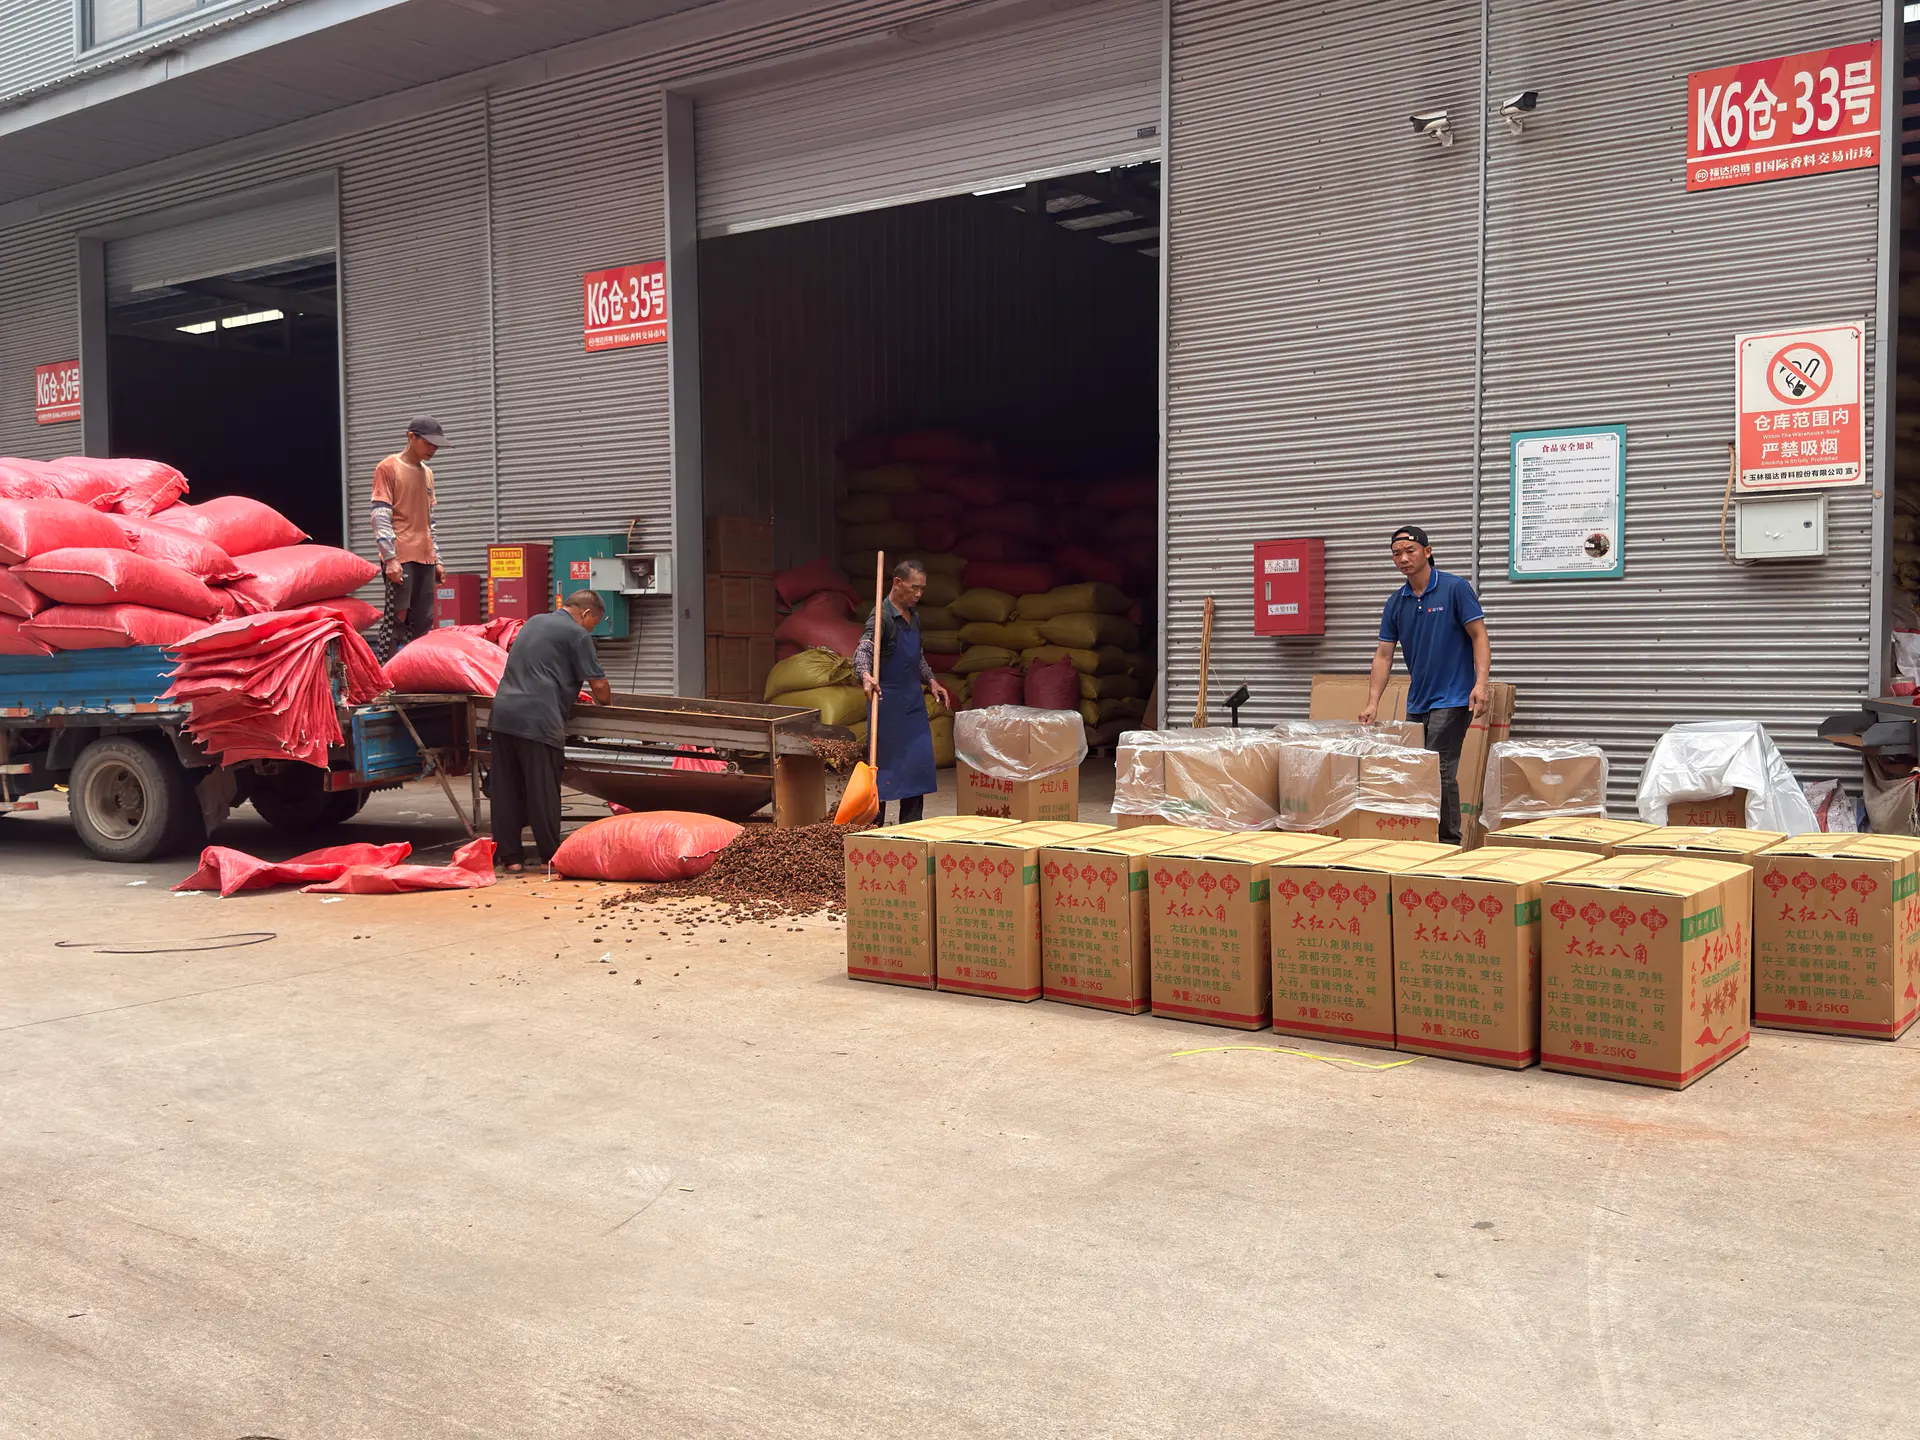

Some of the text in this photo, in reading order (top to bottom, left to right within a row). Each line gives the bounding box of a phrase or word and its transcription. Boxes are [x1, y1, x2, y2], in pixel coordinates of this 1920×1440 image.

[1697, 60, 1875, 151] K6仓-33号
[587, 273, 665, 326] K6仓-35号
[38, 368, 80, 406] K6仓-36号
[1754, 408, 1849, 431] 仓库范围内
[1542, 441, 1594, 453] 食品安全知识
[1762, 438, 1838, 460] 严禁吸烟
[1040, 780, 1069, 794] 大红八角
[1686, 808, 1737, 827] 大红八角
[858, 875, 906, 895] 大红八角
[950, 882, 1002, 904] 大红八角
[1054, 890, 1105, 913] 大红八角
[1165, 899, 1225, 923] 大红八角
[1291, 911, 1360, 936] 大红八角
[1778, 903, 1858, 926] 大红八角
[1413, 922, 1486, 949] 大红八角
[1565, 934, 1647, 965] 大红八角
[975, 969, 997, 980] 25KG
[1080, 979, 1102, 991] 25KG
[1195, 992, 1220, 1005] 25KG
[1816, 1002, 1850, 1014] 25KG
[1324, 1009, 1354, 1022] 25KG
[1449, 1026, 1480, 1040] 25KG
[1602, 1044, 1637, 1060] 25KG
